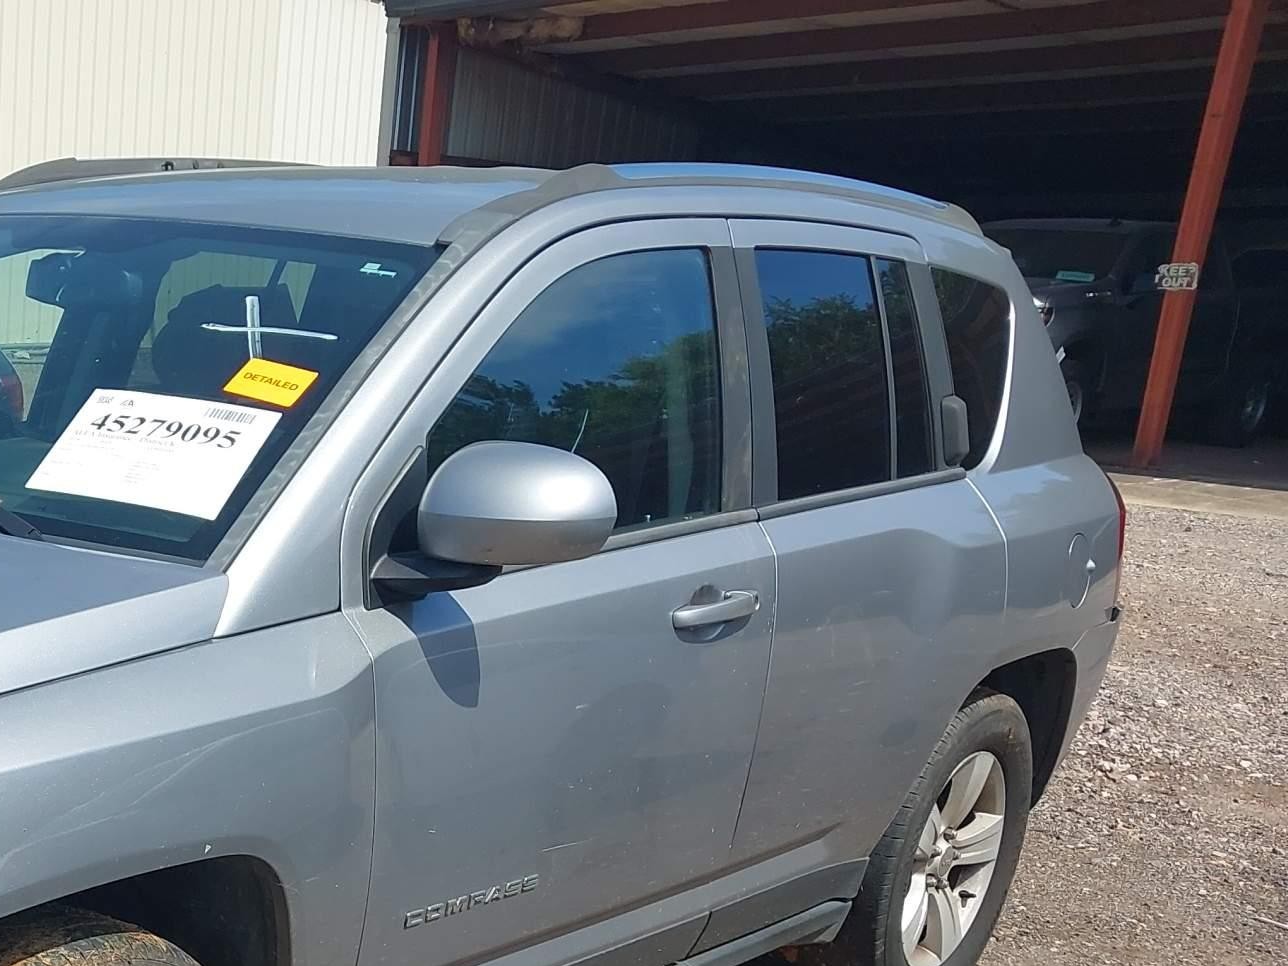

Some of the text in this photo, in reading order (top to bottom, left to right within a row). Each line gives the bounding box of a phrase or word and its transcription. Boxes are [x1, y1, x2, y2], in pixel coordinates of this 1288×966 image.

[1159, 264, 1196, 277] KEEP
[1162, 277, 1192, 288] OUT
[243, 367, 300, 392] DETAILED
[90, 412, 242, 449] 45279095
[404, 873, 539, 930] COMPASS
